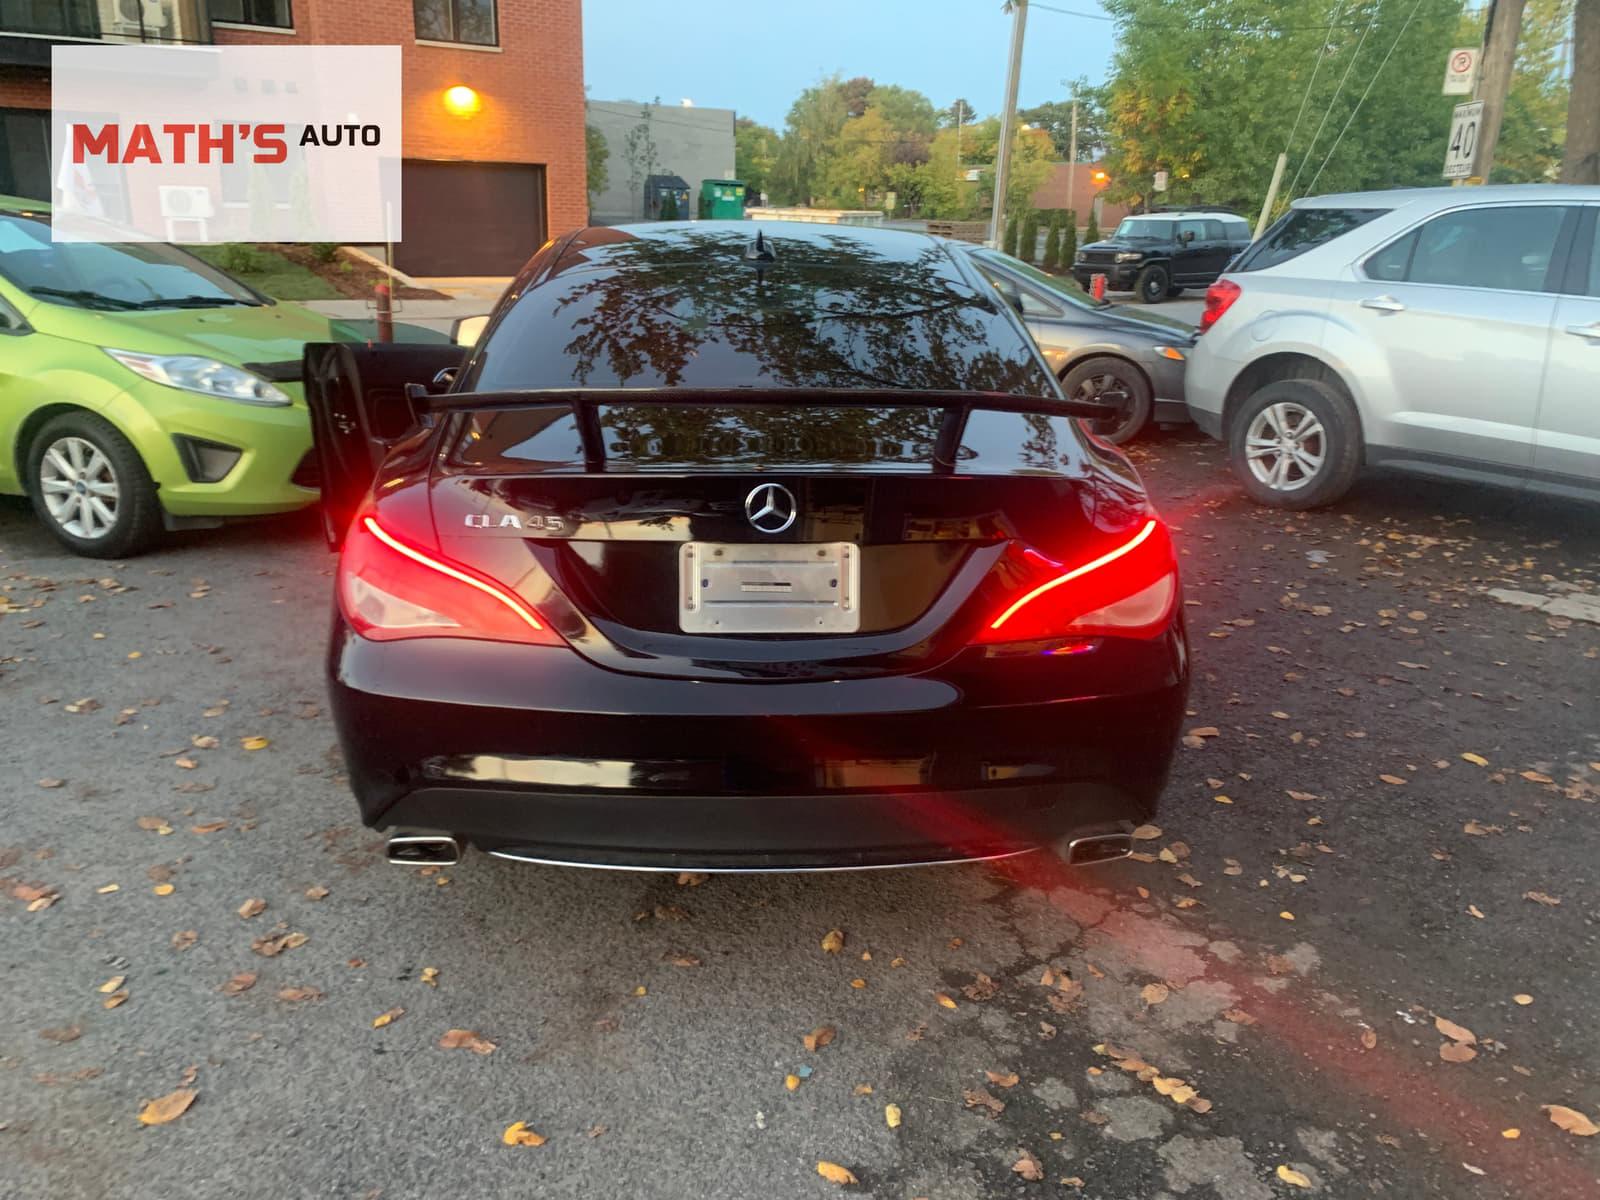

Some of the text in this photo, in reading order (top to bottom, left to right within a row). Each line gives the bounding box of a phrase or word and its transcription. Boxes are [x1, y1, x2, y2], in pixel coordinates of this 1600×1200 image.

[1450, 121, 1476, 160] 40
[464, 514, 564, 531] CLA 45
